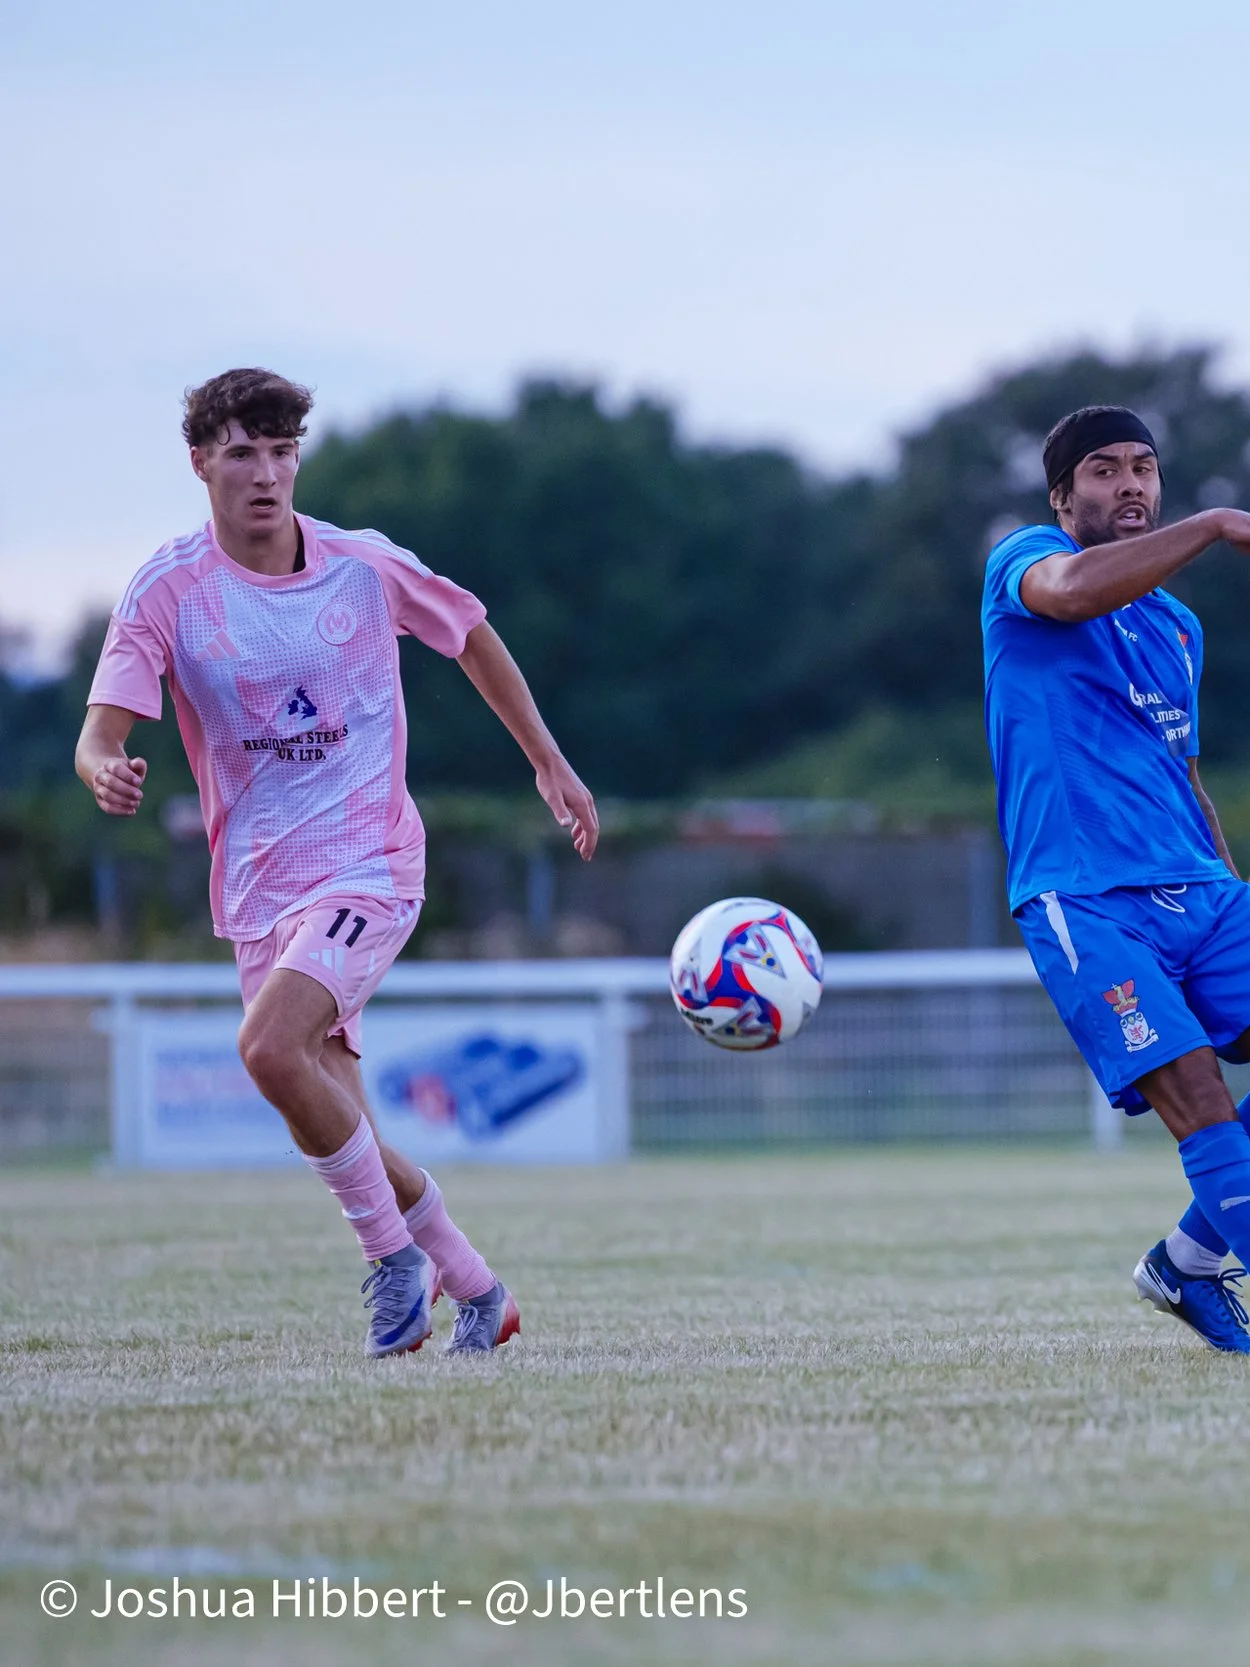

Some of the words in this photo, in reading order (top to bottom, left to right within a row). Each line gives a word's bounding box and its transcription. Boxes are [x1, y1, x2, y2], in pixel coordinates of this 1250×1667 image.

[1128, 631, 1138, 642] FC
[1150, 709, 1181, 723] LITIES
[242, 735, 304, 752] REGIONAL
[306, 723, 349, 744] STEELS
[277, 747, 297, 761] UK
[325, 907, 368, 949] 11
